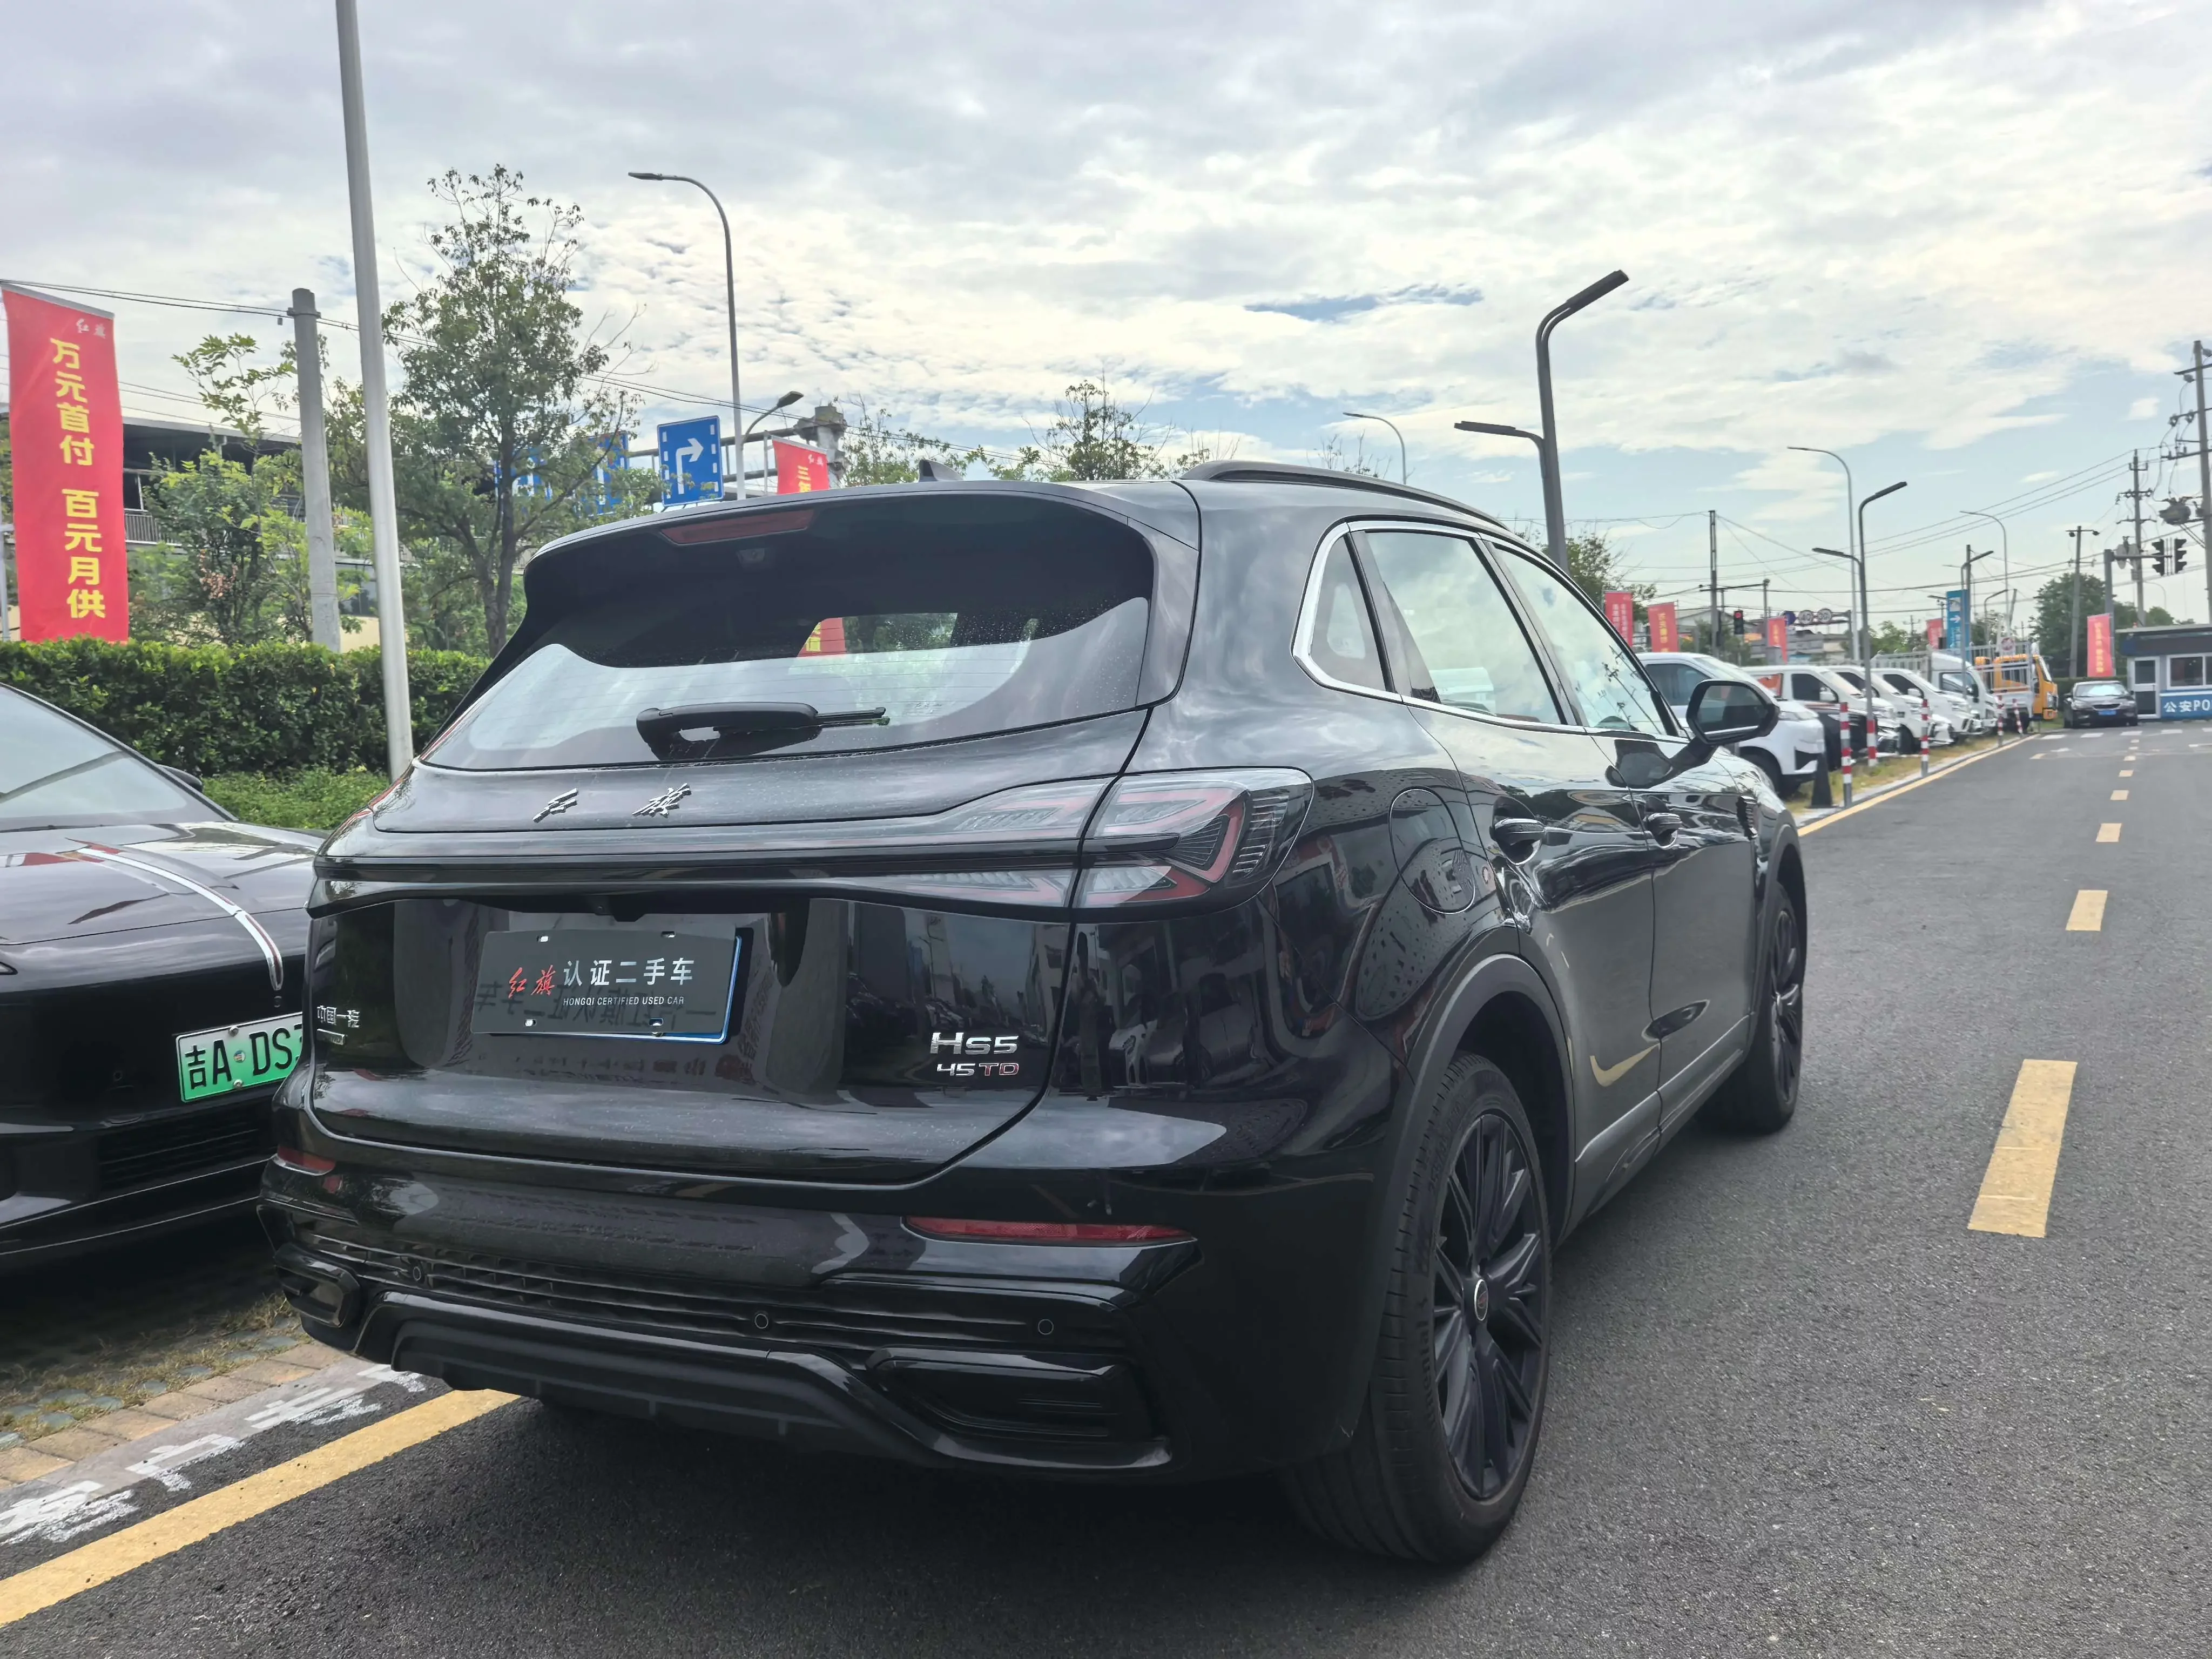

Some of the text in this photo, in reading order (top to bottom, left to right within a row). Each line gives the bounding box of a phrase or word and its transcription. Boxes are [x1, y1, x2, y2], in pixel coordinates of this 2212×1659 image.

[50, 338, 106, 619] 万元首付 百元月供
[2163, 699, 2212, 712] 公安 PO
[508, 957, 694, 998] 红旗 认证二手车
[563, 996, 684, 1006] HONGQI CERTIFIED USED CAR
[930, 1032, 1019, 1055] HS5
